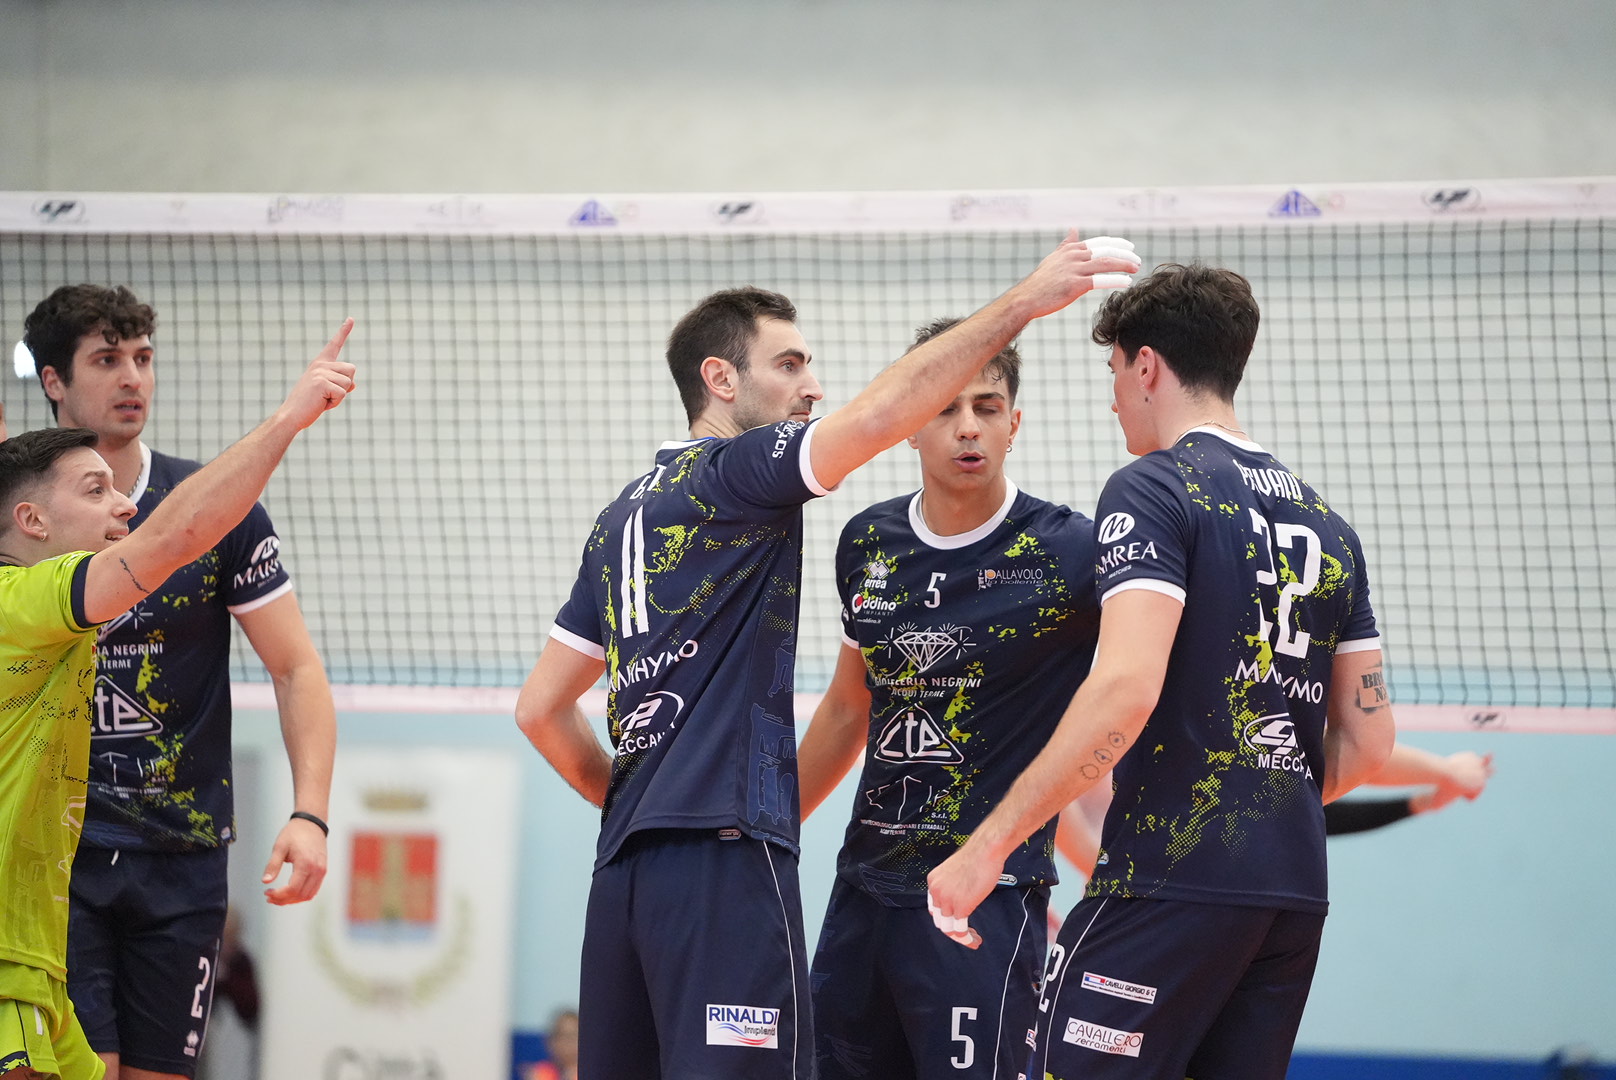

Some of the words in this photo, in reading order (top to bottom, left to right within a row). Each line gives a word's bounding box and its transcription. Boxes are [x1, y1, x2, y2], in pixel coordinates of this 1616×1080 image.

[620, 505, 649, 639] 11
[984, 568, 1043, 583] PALLAVOLO
[924, 571, 947, 608] 5
[1248, 508, 1322, 659] 22
[113, 642, 163, 656] NEGRINI
[102, 659, 132, 670] TERME
[931, 677, 981, 688] NEGRINI
[890, 690, 917, 698] ACQUI
[919, 690, 945, 698] TERME
[190, 956, 211, 1019] 2
[709, 1006, 778, 1025] RINALDI
[950, 1006, 978, 1069] 5
[1067, 1021, 1141, 1048] CAVALLERO
[1075, 1037, 1126, 1053] serramenti
